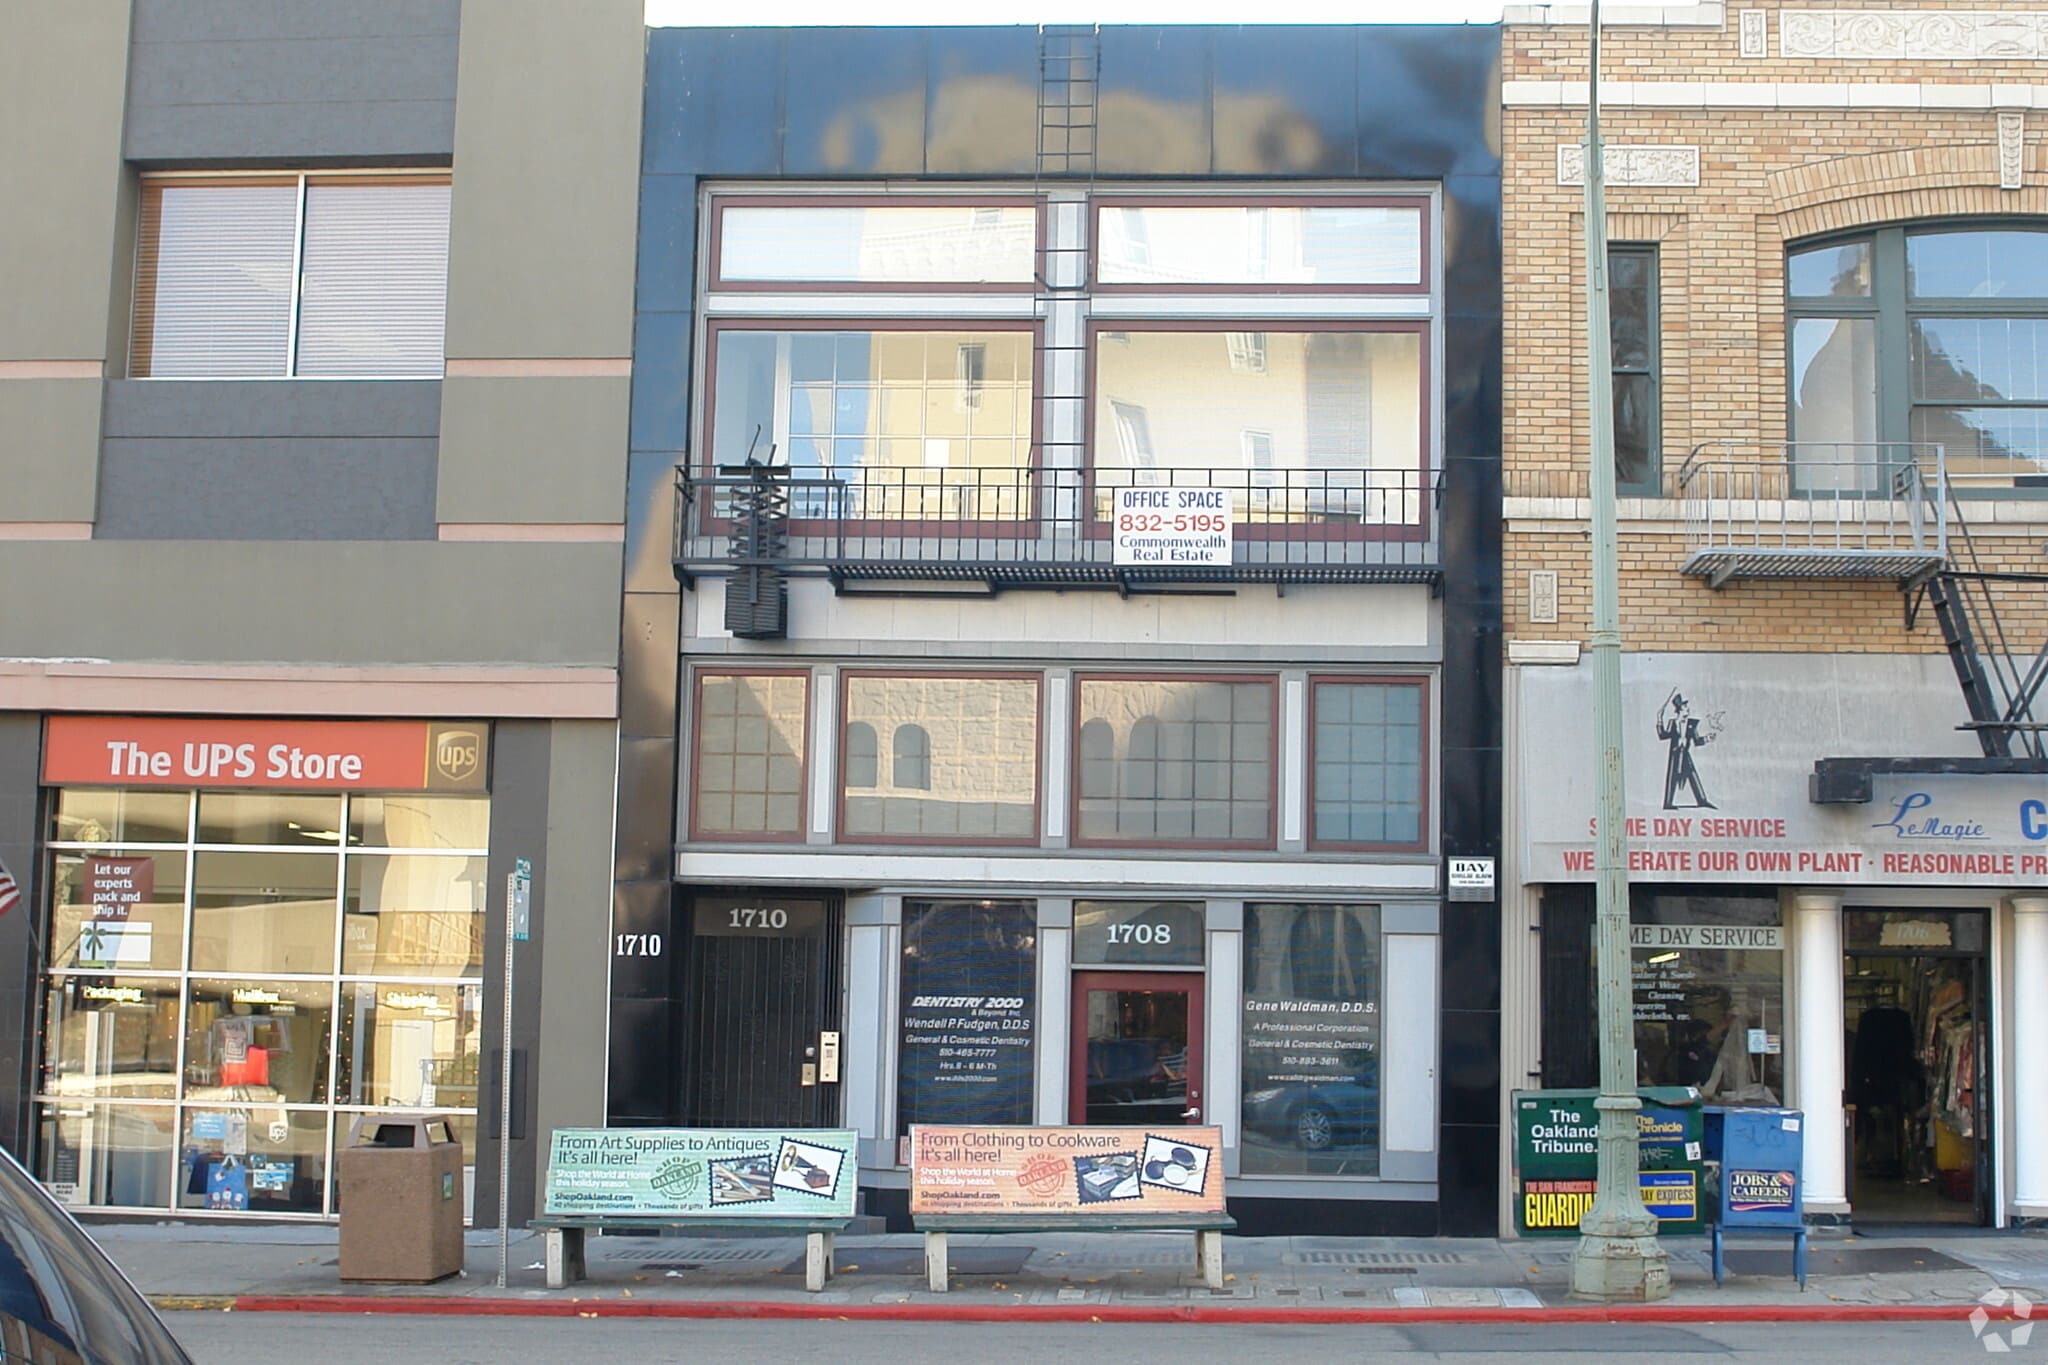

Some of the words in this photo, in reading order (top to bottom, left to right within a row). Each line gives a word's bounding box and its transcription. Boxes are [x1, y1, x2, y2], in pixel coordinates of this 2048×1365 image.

[1123, 491, 1169, 508] OFFICE
[1178, 491, 1223, 508] SPACE
[1120, 514, 1225, 532] 832-5195
[1133, 548, 1163, 561] Real
[1171, 548, 1213, 561] Estate
[106, 741, 172, 777] The
[183, 743, 256, 778] UPS
[266, 744, 363, 780] Store
[440, 746, 476, 773] ups
[1590, 818, 1647, 837] ME
[1653, 818, 1692, 837] DAY
[1700, 818, 1786, 838] SERVICE
[94, 863, 111, 875] Let
[113, 865, 132, 875] our
[1455, 863, 1488, 873] BAY
[1563, 852, 1595, 871] WE
[1628, 852, 1691, 871] ERATE
[1698, 852, 1738, 872] OUR
[1745, 852, 1791, 872] OWN
[1799, 852, 1862, 873] PLANT
[1883, 853, 2014, 875] REASONABLE
[94, 879, 133, 891] experts
[93, 891, 118, 904] pack
[120, 891, 141, 902] and
[93, 904, 114, 918] ship
[117, 904, 128, 916] it.
[729, 908, 788, 929] 1710
[1106, 924, 1171, 944] 1708
[1630, 928, 1652, 945] ME
[1660, 928, 1693, 945] DAY
[1701, 929, 1776, 946] SERVICE
[616, 934, 662, 957] 1710
[912, 996, 985, 1008] DENTISTRY
[985, 997, 1024, 1009] 2000
[1246, 1001, 1278, 1011] Gene
[1280, 1001, 1339, 1013] Waldman,
[1341, 1002, 1378, 1013] D.D.S.
[904, 1018, 947, 1028] Wendell
[957, 1019, 1000, 1031] Fudgen,
[1253, 1023, 1260, 1031] A
[1261, 1022, 1316, 1032] Professional
[1317, 1024, 1369, 1034] Corporation
[905, 1034, 940, 1043] General
[941, 1034, 948, 1044] &
[949, 1035, 990, 1044] Cosmetic
[991, 1036, 1031, 1047] Dentistry
[1248, 1040, 1284, 1048] General
[1285, 1040, 1290, 1048] &
[1291, 1040, 1333, 1049] Cosmetic
[1334, 1041, 1374, 1051] Dentistry
[1550, 1109, 1581, 1123] The
[1531, 1125, 1598, 1138] Oakland
[1638, 1122, 1683, 1133] hronicle
[560, 1135, 597, 1149] From
[600, 1136, 623, 1150] Art
[625, 1136, 685, 1153] Supplies
[689, 1138, 703, 1150] to
[706, 1136, 770, 1153] Antiques
[921, 1132, 958, 1146] From
[962, 1132, 1025, 1150] Clothing
[1029, 1134, 1044, 1147] to
[1047, 1133, 1121, 1147] Cookware
[1532, 1140, 1598, 1153] Tribune.
[558, 1151, 578, 1164] It's
[581, 1151, 598, 1164] all
[602, 1151, 638, 1165] here!
[921, 1150, 941, 1161] It's
[944, 1149, 960, 1161] all
[964, 1150, 1001, 1162] here!
[555, 1170, 577, 1179] Shop
[578, 1169, 592, 1179] the
[593, 1169, 617, 1179] World
[618, 1170, 627, 1179] at
[652, 1162, 702, 1188] OAKLAND
[920, 1168, 942, 1178] Shop
[943, 1167, 957, 1177] the
[958, 1168, 981, 1177] World
[983, 1168, 991, 1177] at
[992, 1168, 1016, 1177] Home
[1017, 1159, 1068, 1187] OAKLAND
[555, 1178, 570, 1187] this
[571, 1178, 600, 1188] holiday
[601, 1180, 629, 1188] season.
[920, 1177, 935, 1185] this
[936, 1176, 965, 1186] holiday
[967, 1178, 996, 1186] season.
[1733, 1174, 1769, 1187] JOBS
[1770, 1175, 1782, 1187] &
[555, 1192, 633, 1202] ShopOakland.com
[921, 1191, 1001, 1200] ShopOakland.com
[1656, 1190, 1694, 1204] express
[1733, 1186, 1789, 1197] CAREERS
